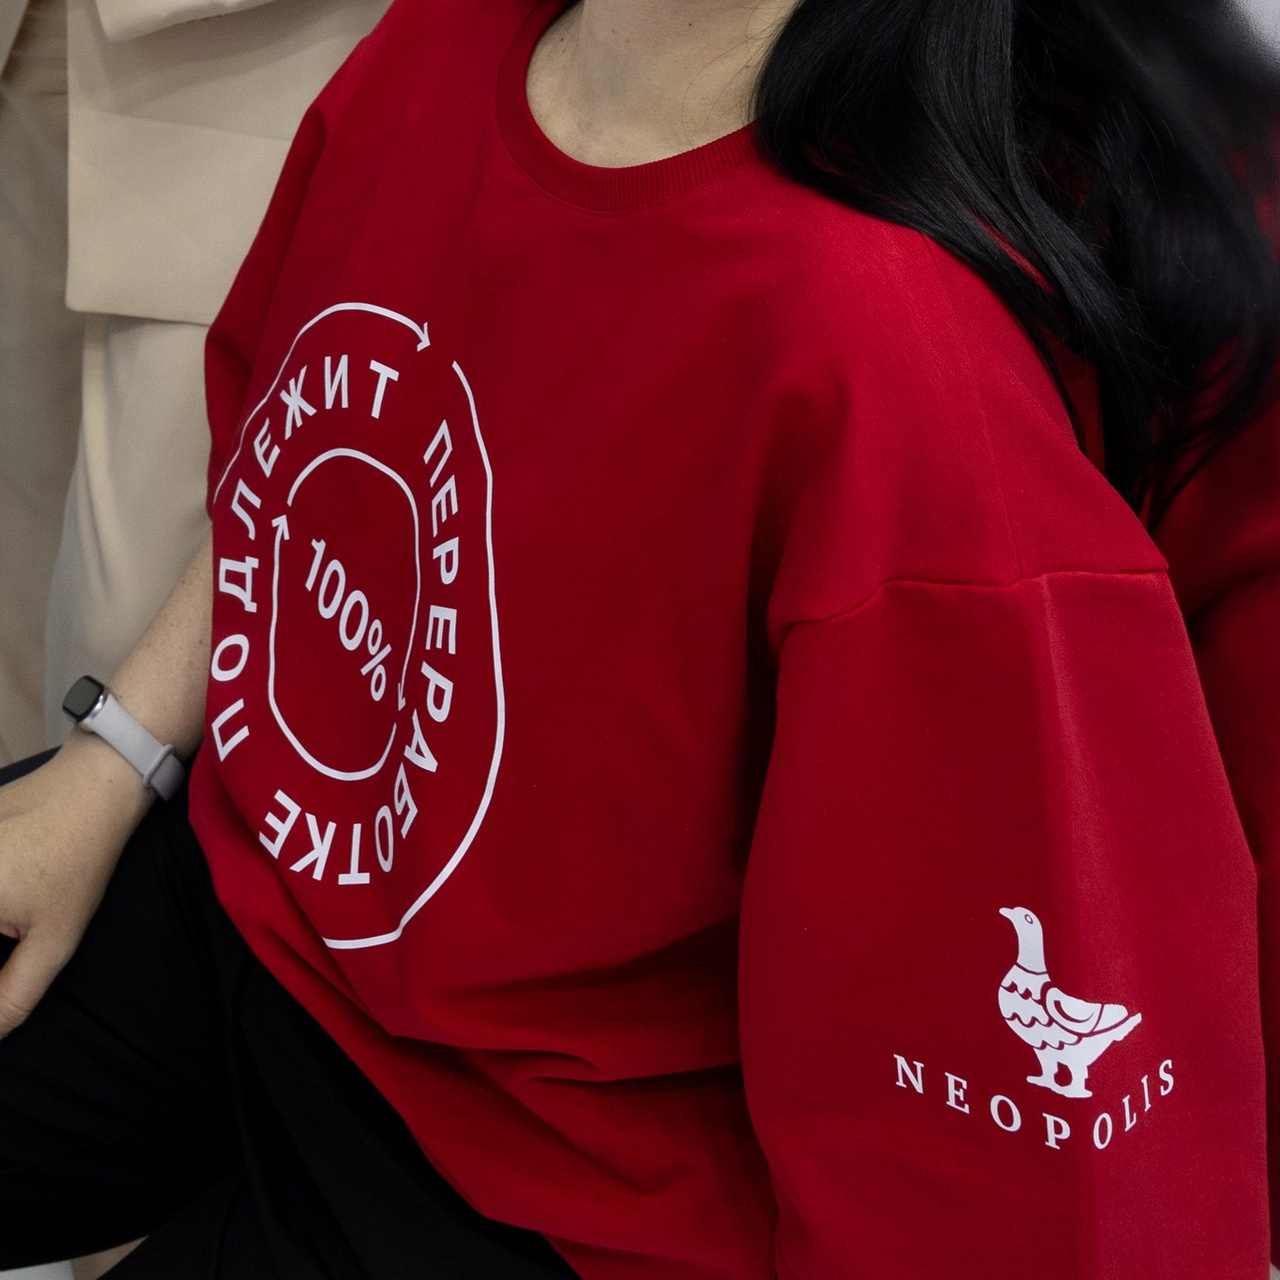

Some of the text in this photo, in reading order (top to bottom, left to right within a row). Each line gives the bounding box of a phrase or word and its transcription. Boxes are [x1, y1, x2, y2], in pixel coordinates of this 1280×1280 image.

[211, 353, 459, 887] ПОДЛЕЖИТ ПЕРЕРАБОТКЕ
[304, 537, 394, 703] 100%
[892, 1053, 1175, 1151] NEOPOLIS
